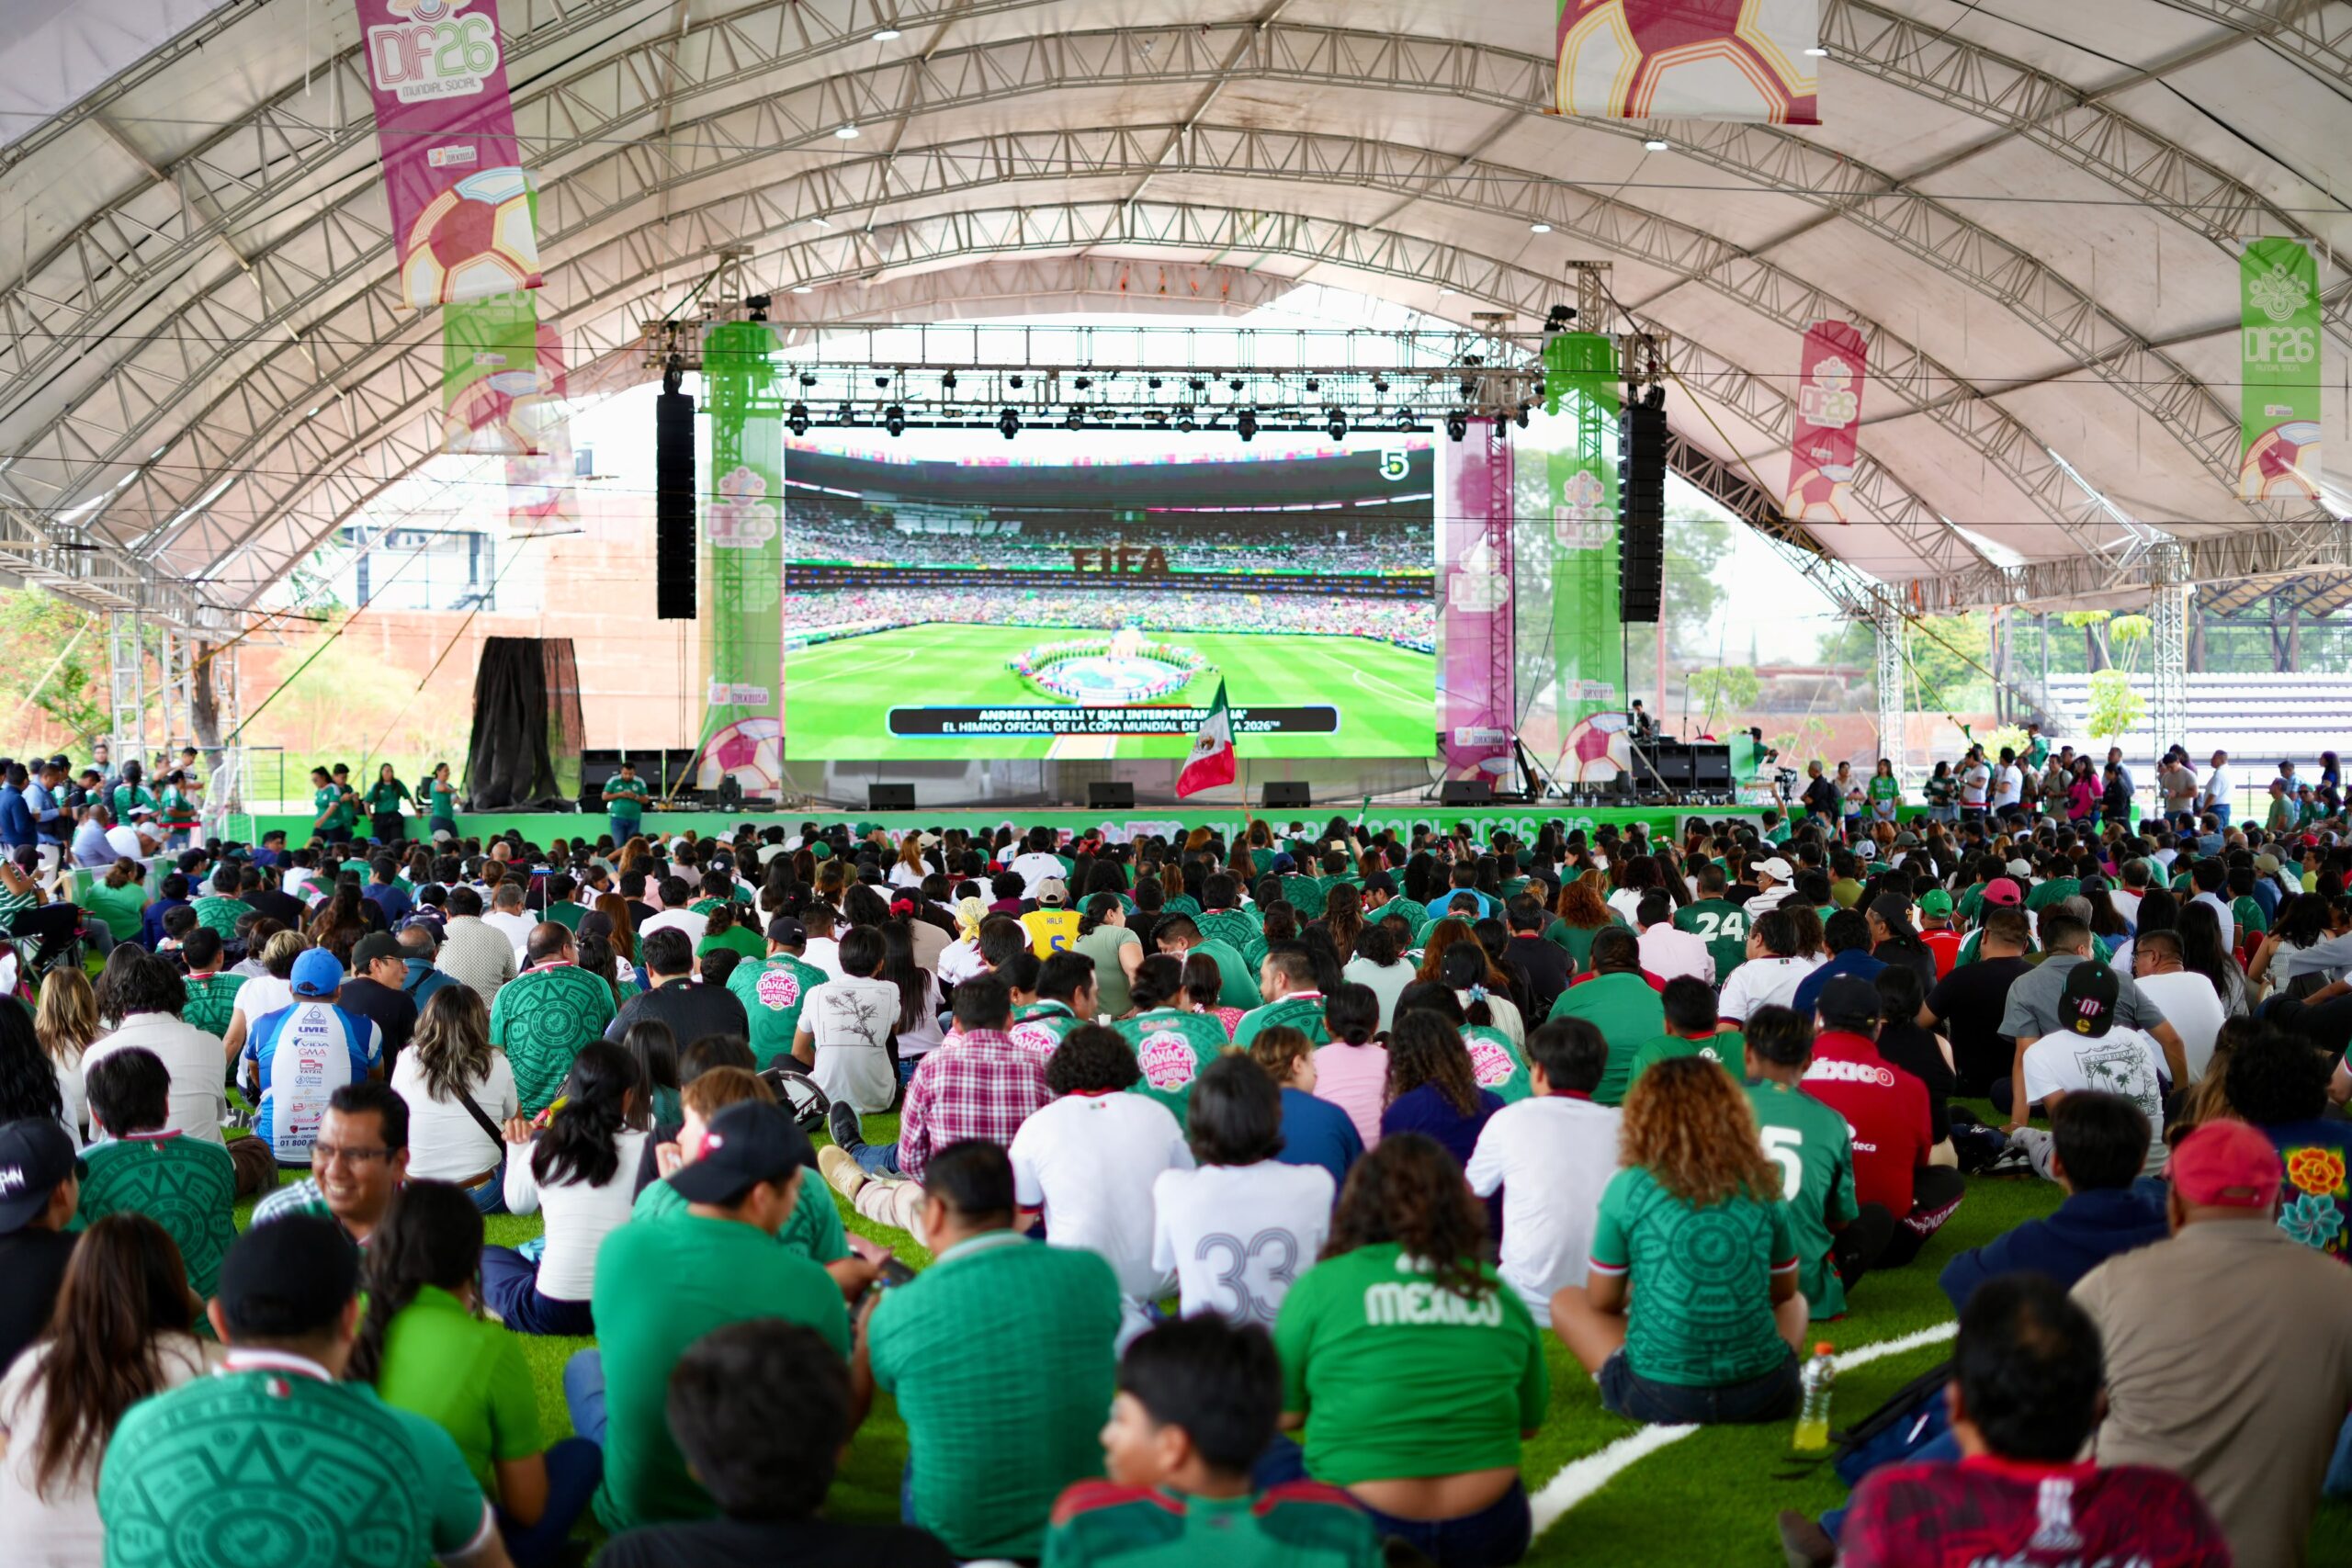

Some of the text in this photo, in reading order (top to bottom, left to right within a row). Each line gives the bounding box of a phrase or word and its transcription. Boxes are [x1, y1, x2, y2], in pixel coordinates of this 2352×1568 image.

[374, 17, 496, 85] DIF26
[402, 77, 477, 97] MUNDIAL SOCIAL
[2245, 326, 2315, 363] DIF26
[1801, 387, 1856, 420] DIF26
[1379, 447, 1409, 481] 5
[1073, 546, 1170, 576] FIFA
[943, 722, 956, 733] EL
[959, 721, 1002, 732] HIMNO
[1004, 721, 1051, 732] OFICIAL
[1053, 721, 1069, 732] DE
[1071, 721, 1086, 732] LA
[1088, 721, 1122, 732] COPA
[1123, 721, 1180, 732] MUNDIAL
[1182, 721, 1197, 732] DE
[978, 710, 1027, 721] ANDREA
[1033, 710, 1085, 721] BOCELLI
[1087, 710, 1096, 720] Y
[1097, 709, 1125, 722] EJAE
[1695, 911, 1745, 942] 24
[759, 980, 797, 995] OAXACA
[762, 993, 792, 1004] MUNDIAL
[298, 1048, 327, 1057] GMA
[1140, 1045, 1193, 1069] OAXACA
[1149, 1066, 1192, 1083] MUNDIAL
[1760, 1125, 1804, 1201] 5
[1194, 1227, 1298, 1325] 33
